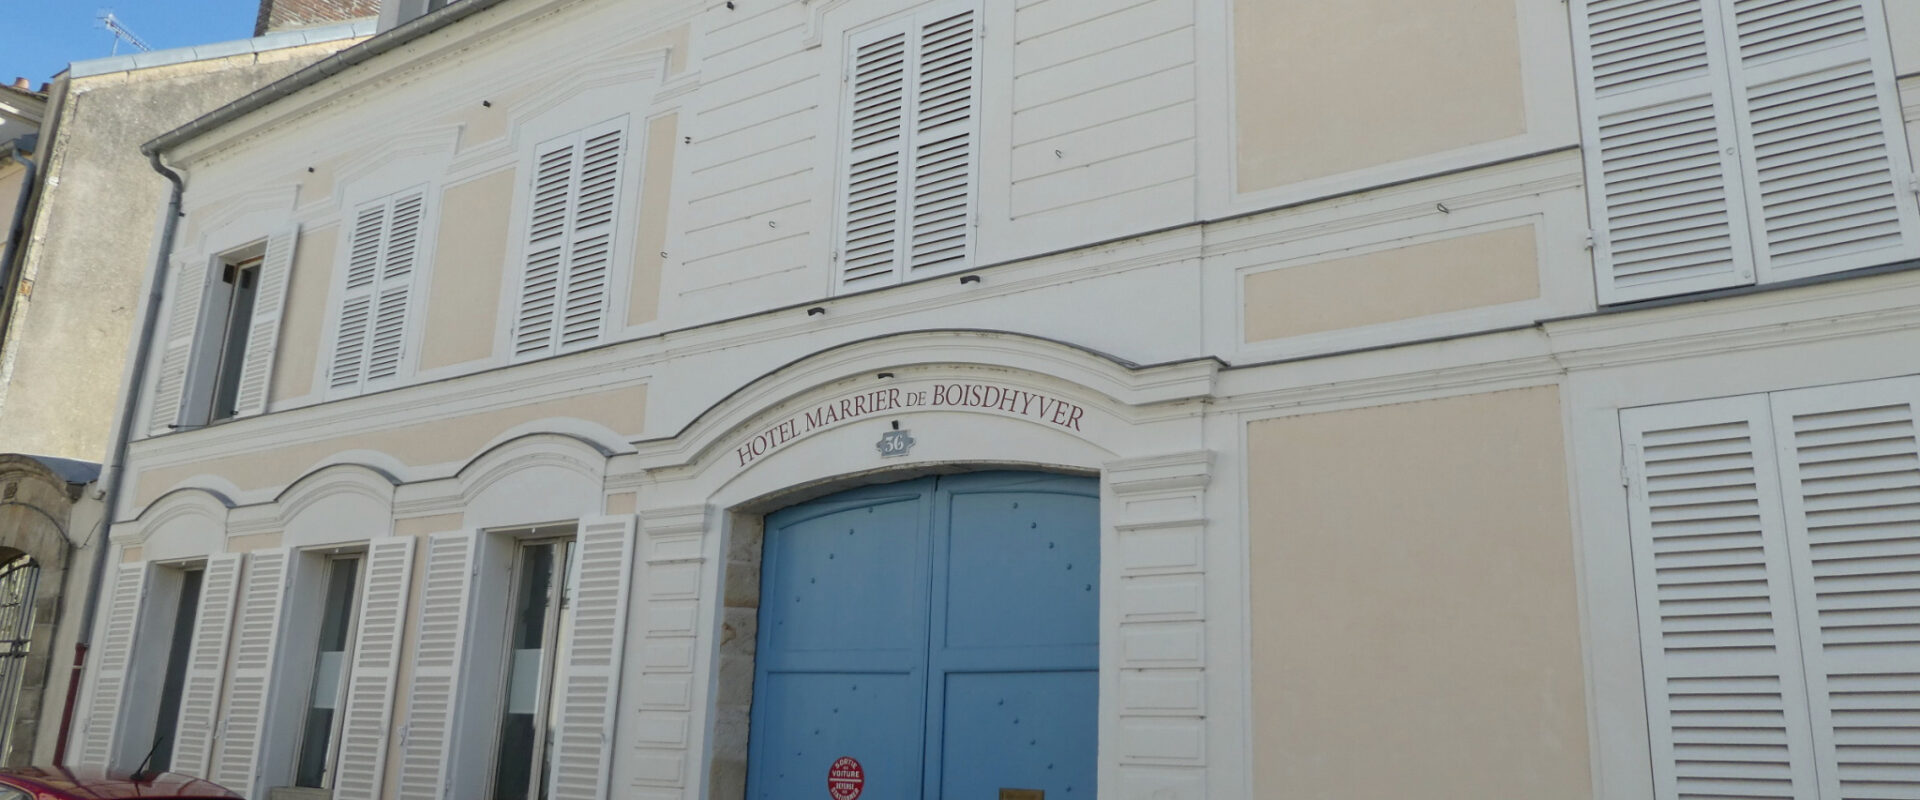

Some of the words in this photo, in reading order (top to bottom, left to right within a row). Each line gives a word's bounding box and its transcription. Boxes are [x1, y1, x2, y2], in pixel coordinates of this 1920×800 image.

[737, 418, 800, 467] HOTEL
[805, 388, 902, 432] MARRIER
[906, 391, 927, 407] DE
[932, 384, 1084, 431] BOISDHYVER
[885, 434, 904, 452] 36
